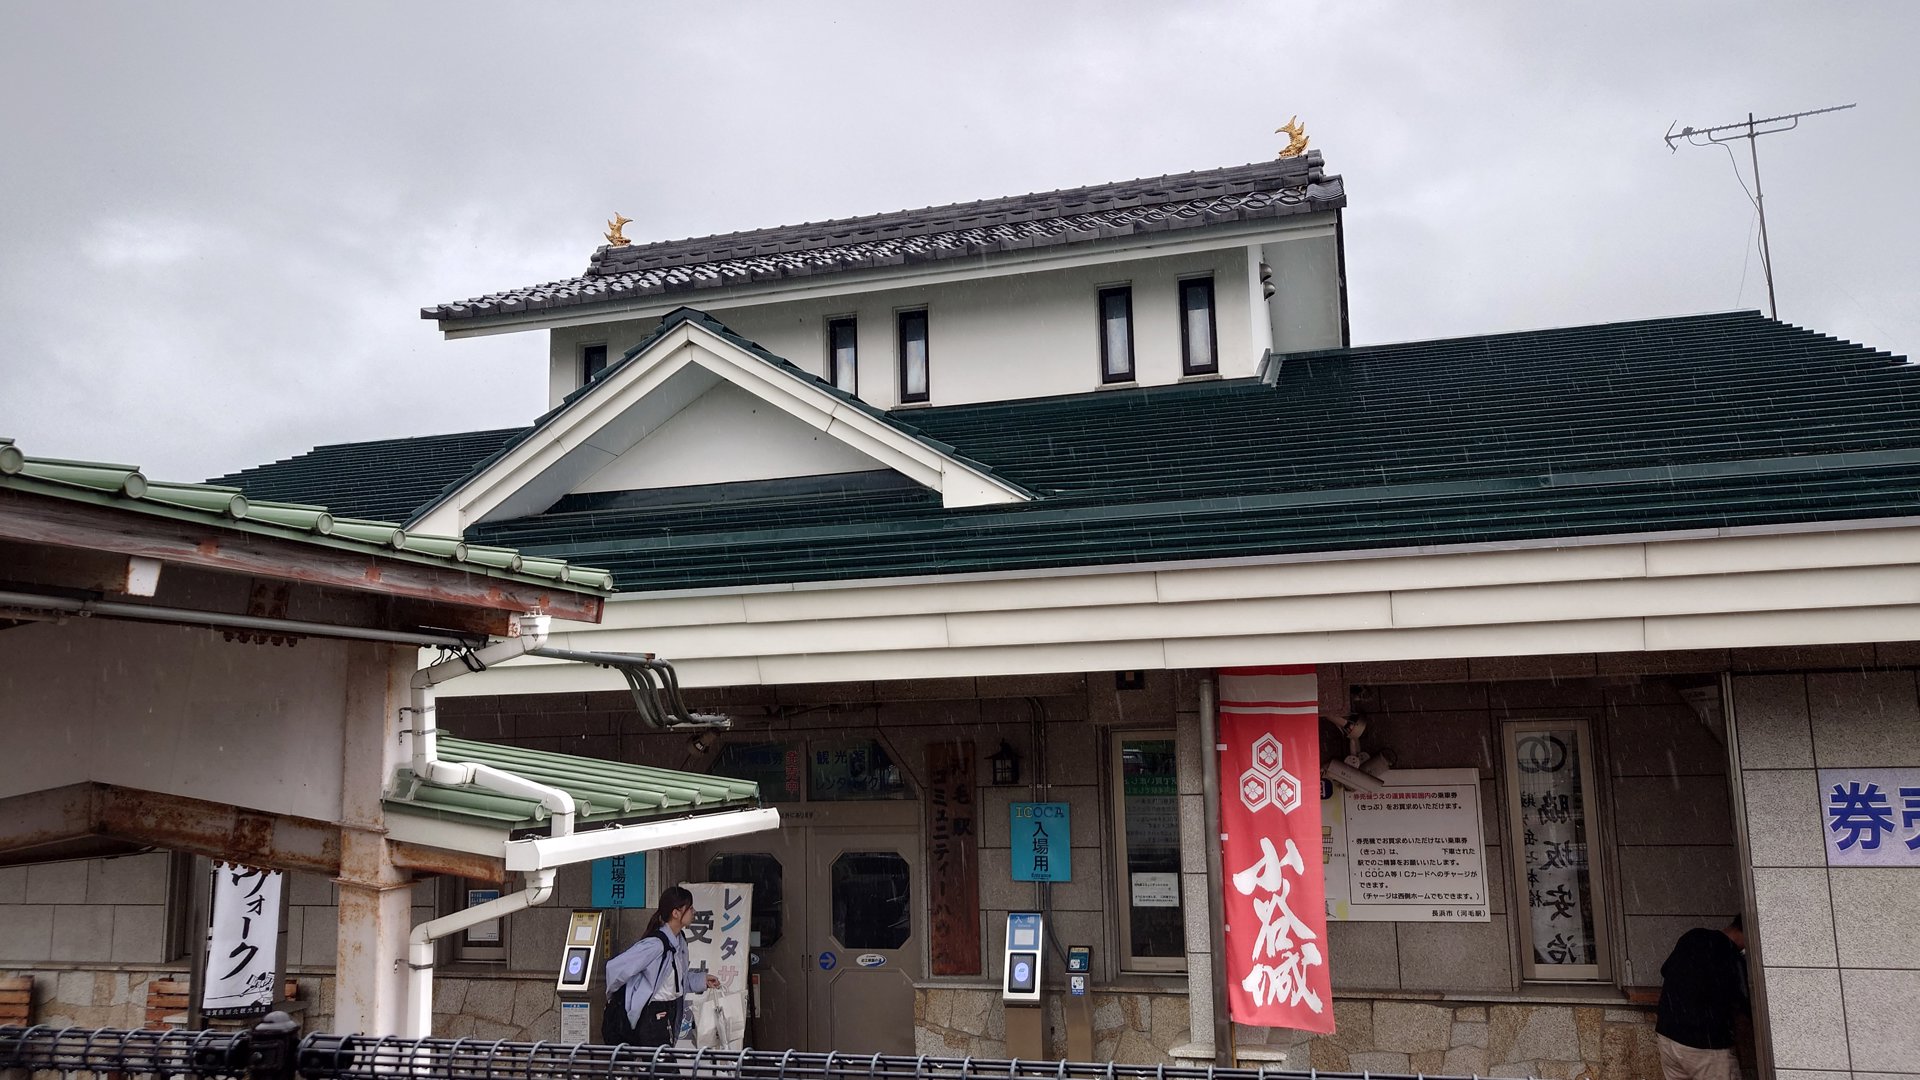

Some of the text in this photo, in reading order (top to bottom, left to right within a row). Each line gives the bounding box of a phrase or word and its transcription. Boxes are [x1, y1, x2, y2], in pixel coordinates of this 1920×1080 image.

[1016, 806, 1064, 818] ICOCA
[1033, 822, 1048, 870] 入場用
[611, 855, 625, 898] 出場用
[1432, 909, 1486, 917] 長浜市（河毛駅）
